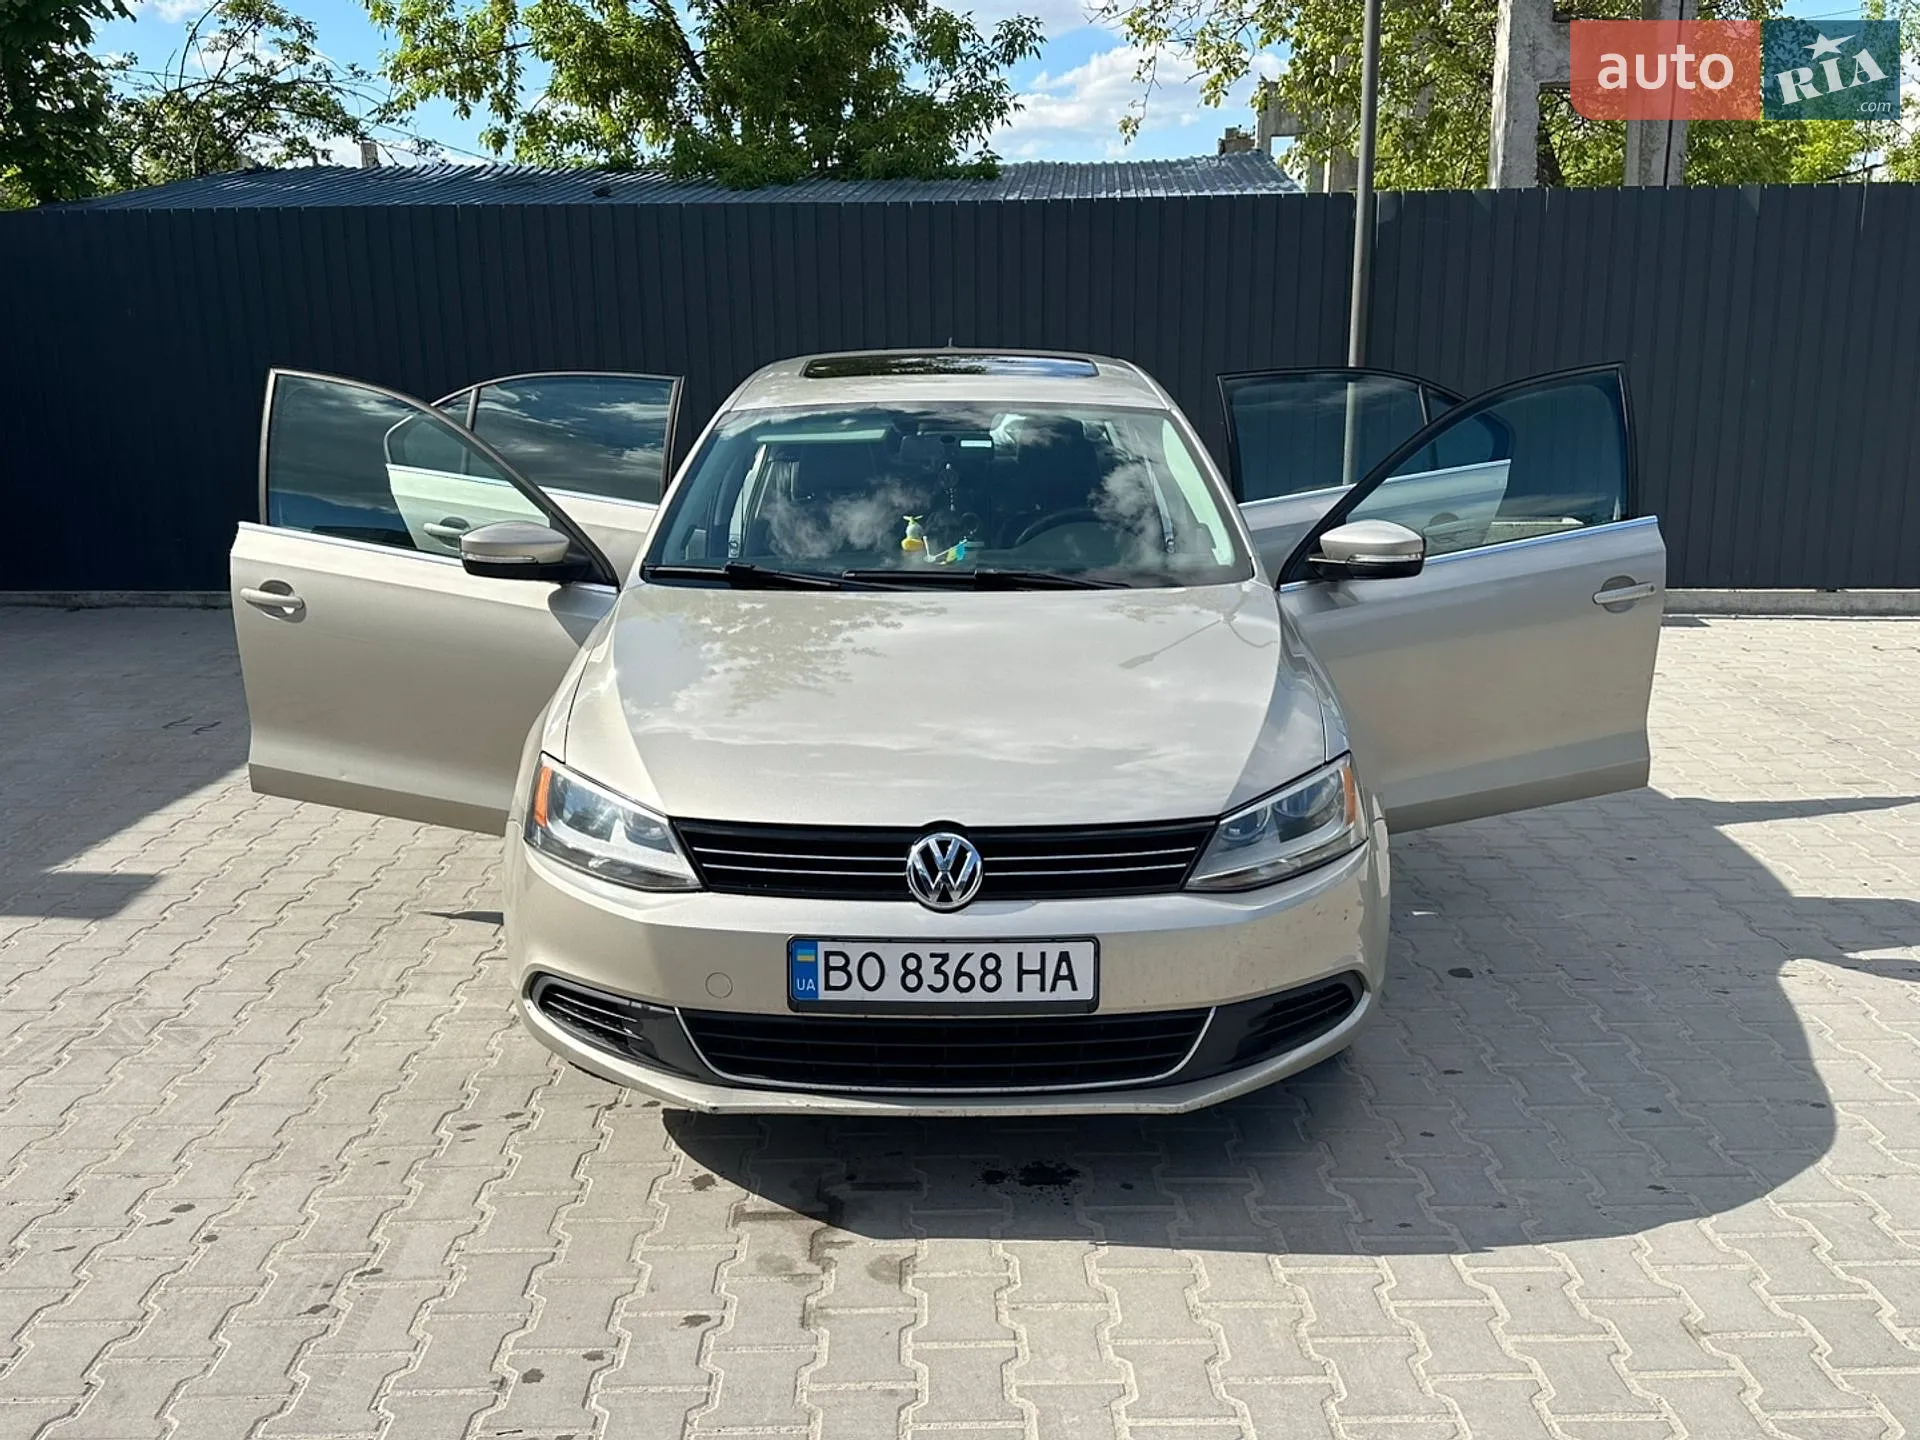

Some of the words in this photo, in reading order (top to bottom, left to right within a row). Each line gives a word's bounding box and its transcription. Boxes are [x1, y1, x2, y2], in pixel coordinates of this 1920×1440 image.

[796, 979, 816, 991] UA
[823, 951, 885, 992] BO
[900, 952, 1002, 993] 8368
[1017, 951, 1078, 993] HA
